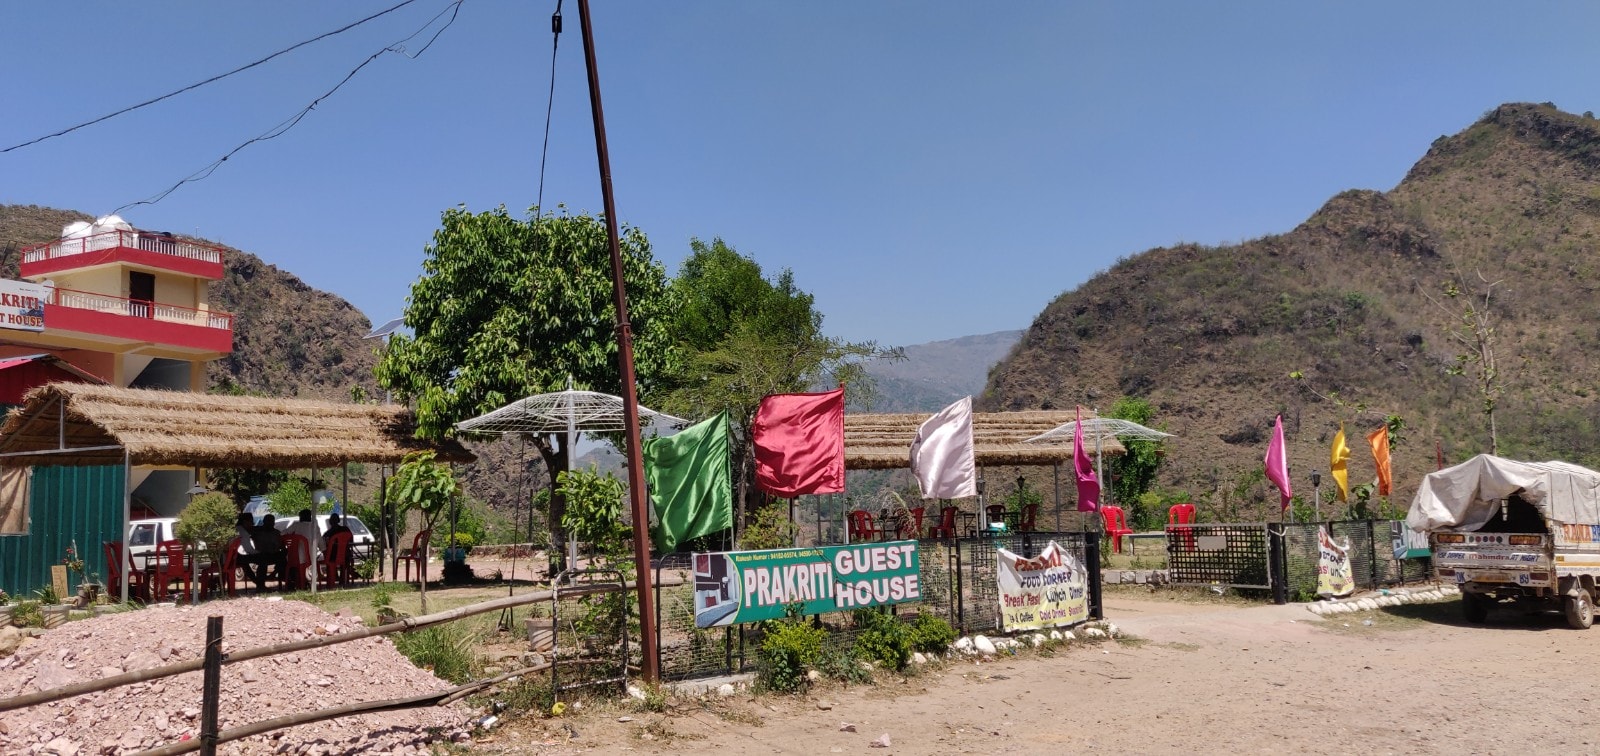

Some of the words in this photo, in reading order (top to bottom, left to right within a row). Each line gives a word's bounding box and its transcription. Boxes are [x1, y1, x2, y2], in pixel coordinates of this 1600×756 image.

[0, 293, 39, 310] KRITI
[8, 314, 42, 327] HOUSE
[834, 544, 915, 575] GUEST
[1520, 554, 1540, 562] NIGHT
[743, 562, 834, 607] PRAKRITI
[1020, 575, 1040, 588] FOOD
[834, 574, 919, 608] HOUSE
[1020, 611, 1034, 623] Coffee
